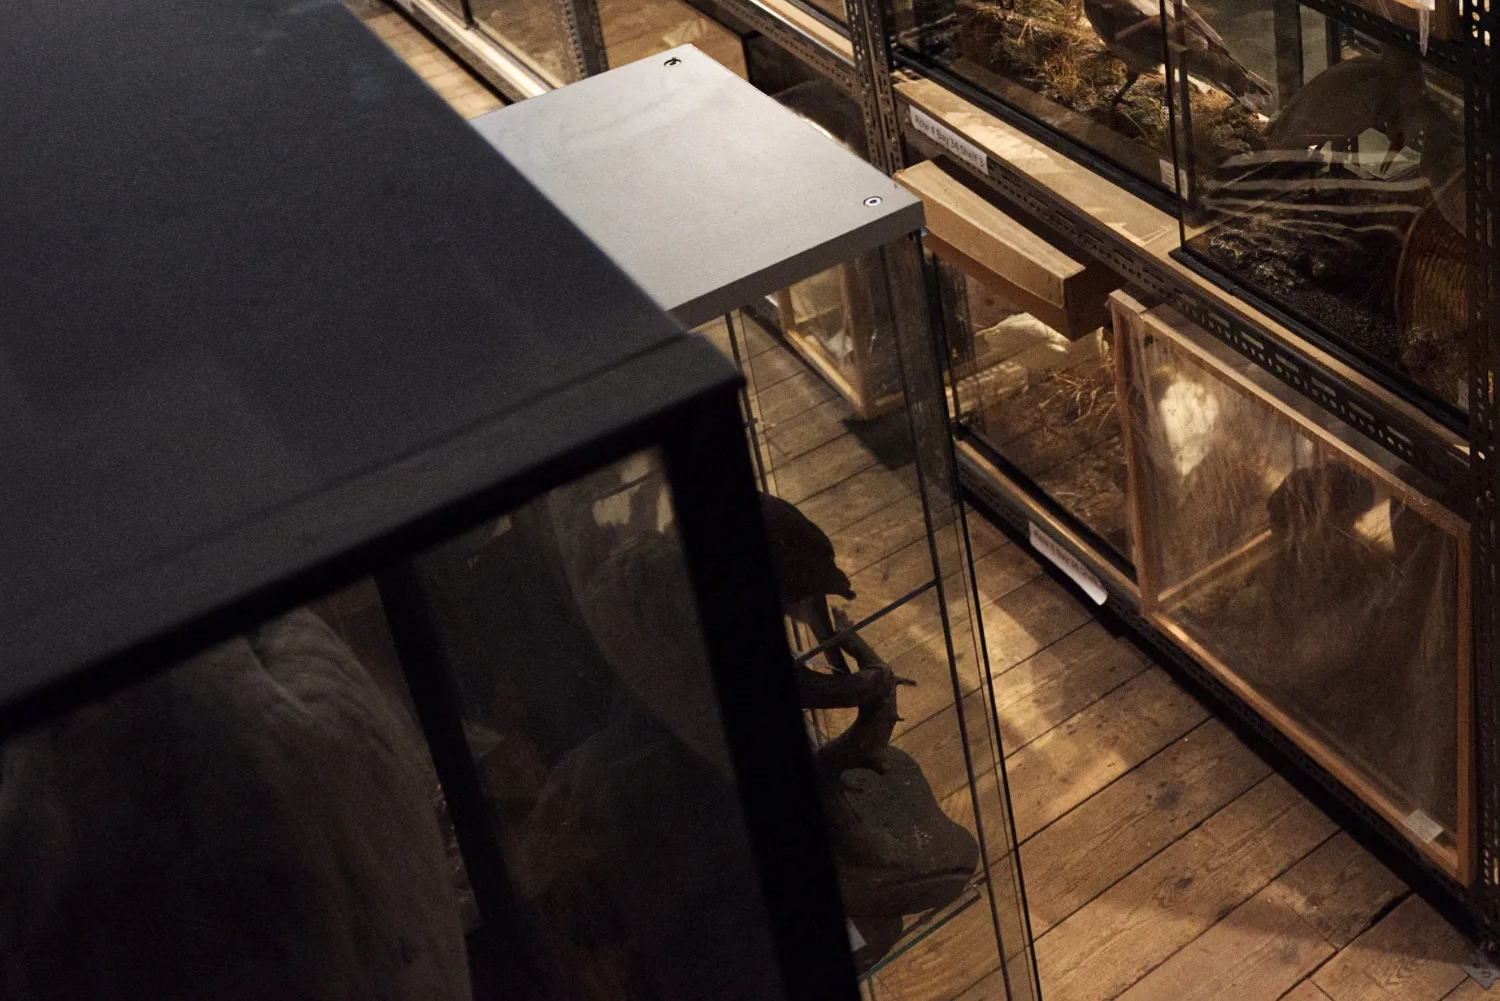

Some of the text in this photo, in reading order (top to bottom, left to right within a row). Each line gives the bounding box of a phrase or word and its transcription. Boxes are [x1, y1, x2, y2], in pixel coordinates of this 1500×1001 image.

[914, 114, 930, 131] Row
[930, 126, 936, 135] 4
[936, 128, 950, 146] Bay
[949, 138, 959, 151] 34
[960, 144, 979, 161] Shelf
